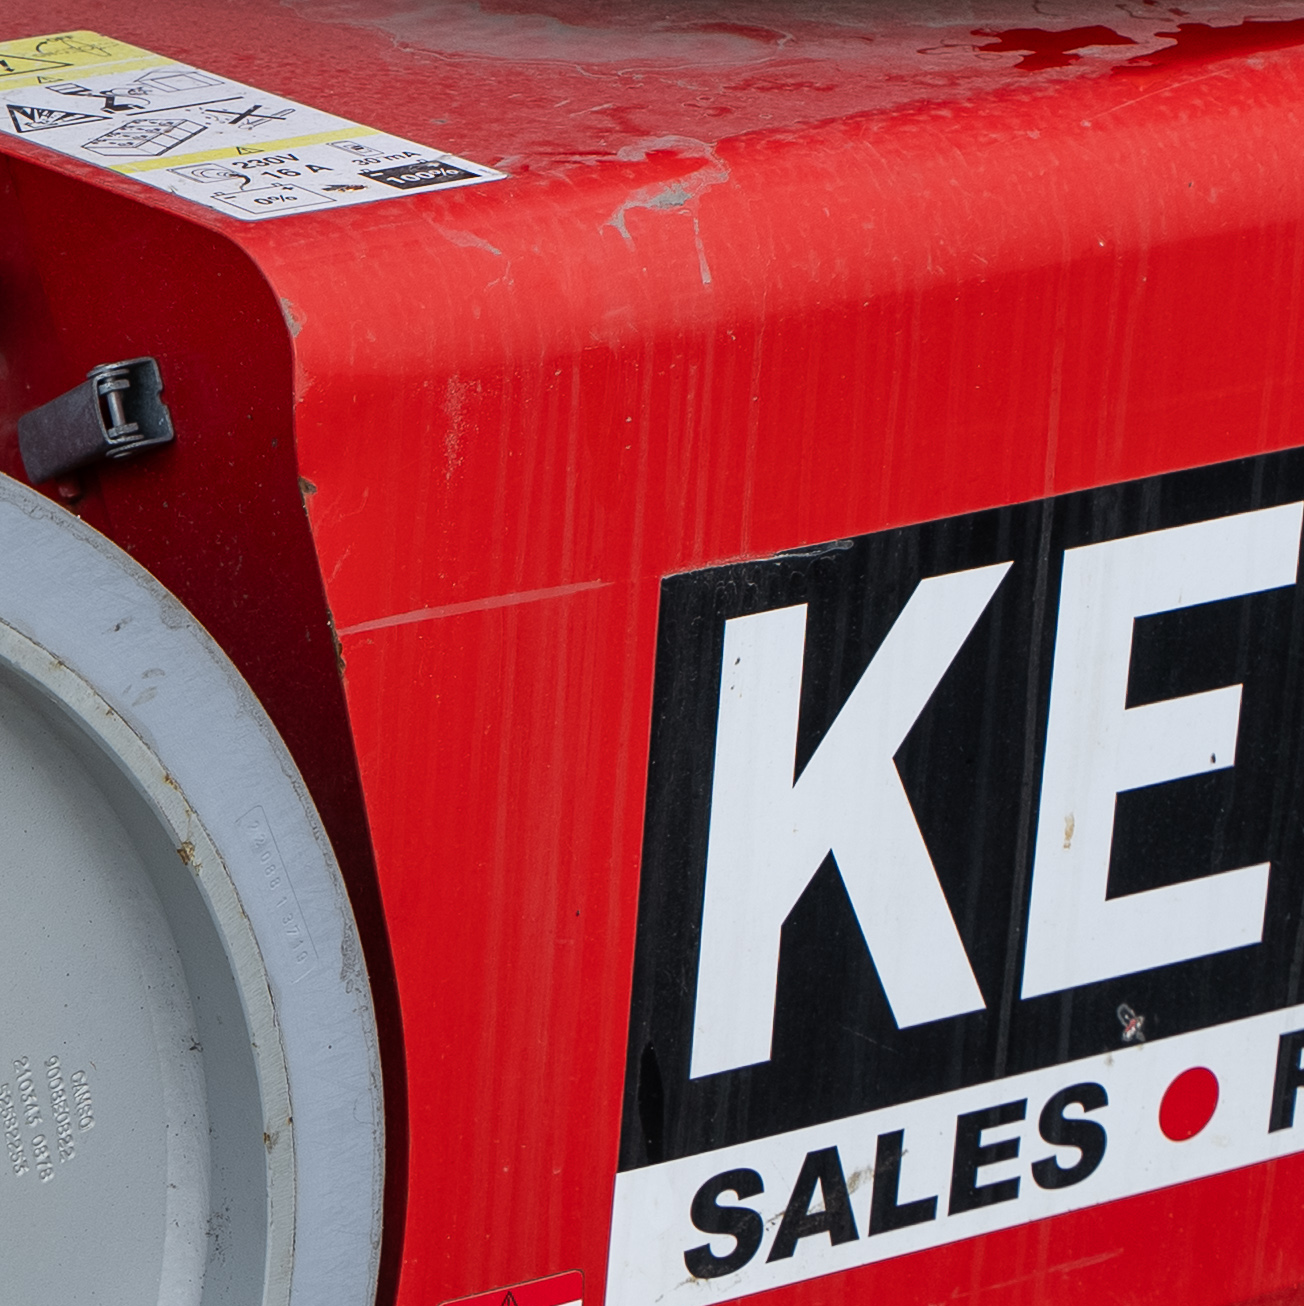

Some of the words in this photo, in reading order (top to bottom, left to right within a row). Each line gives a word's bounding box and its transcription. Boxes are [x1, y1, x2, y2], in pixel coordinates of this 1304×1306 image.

[232, 153, 299, 169] 230V
[352, 157, 381, 166] 30
[384, 151, 422, 161] mA
[261, 168, 302, 179] 16
[305, 164, 334, 173] A
[386, 168, 460, 185] 100%
[254, 194, 298, 205] 0%
[690, 502, 1304, 1080] KE
[682, 1081, 1110, 1281] SALES
